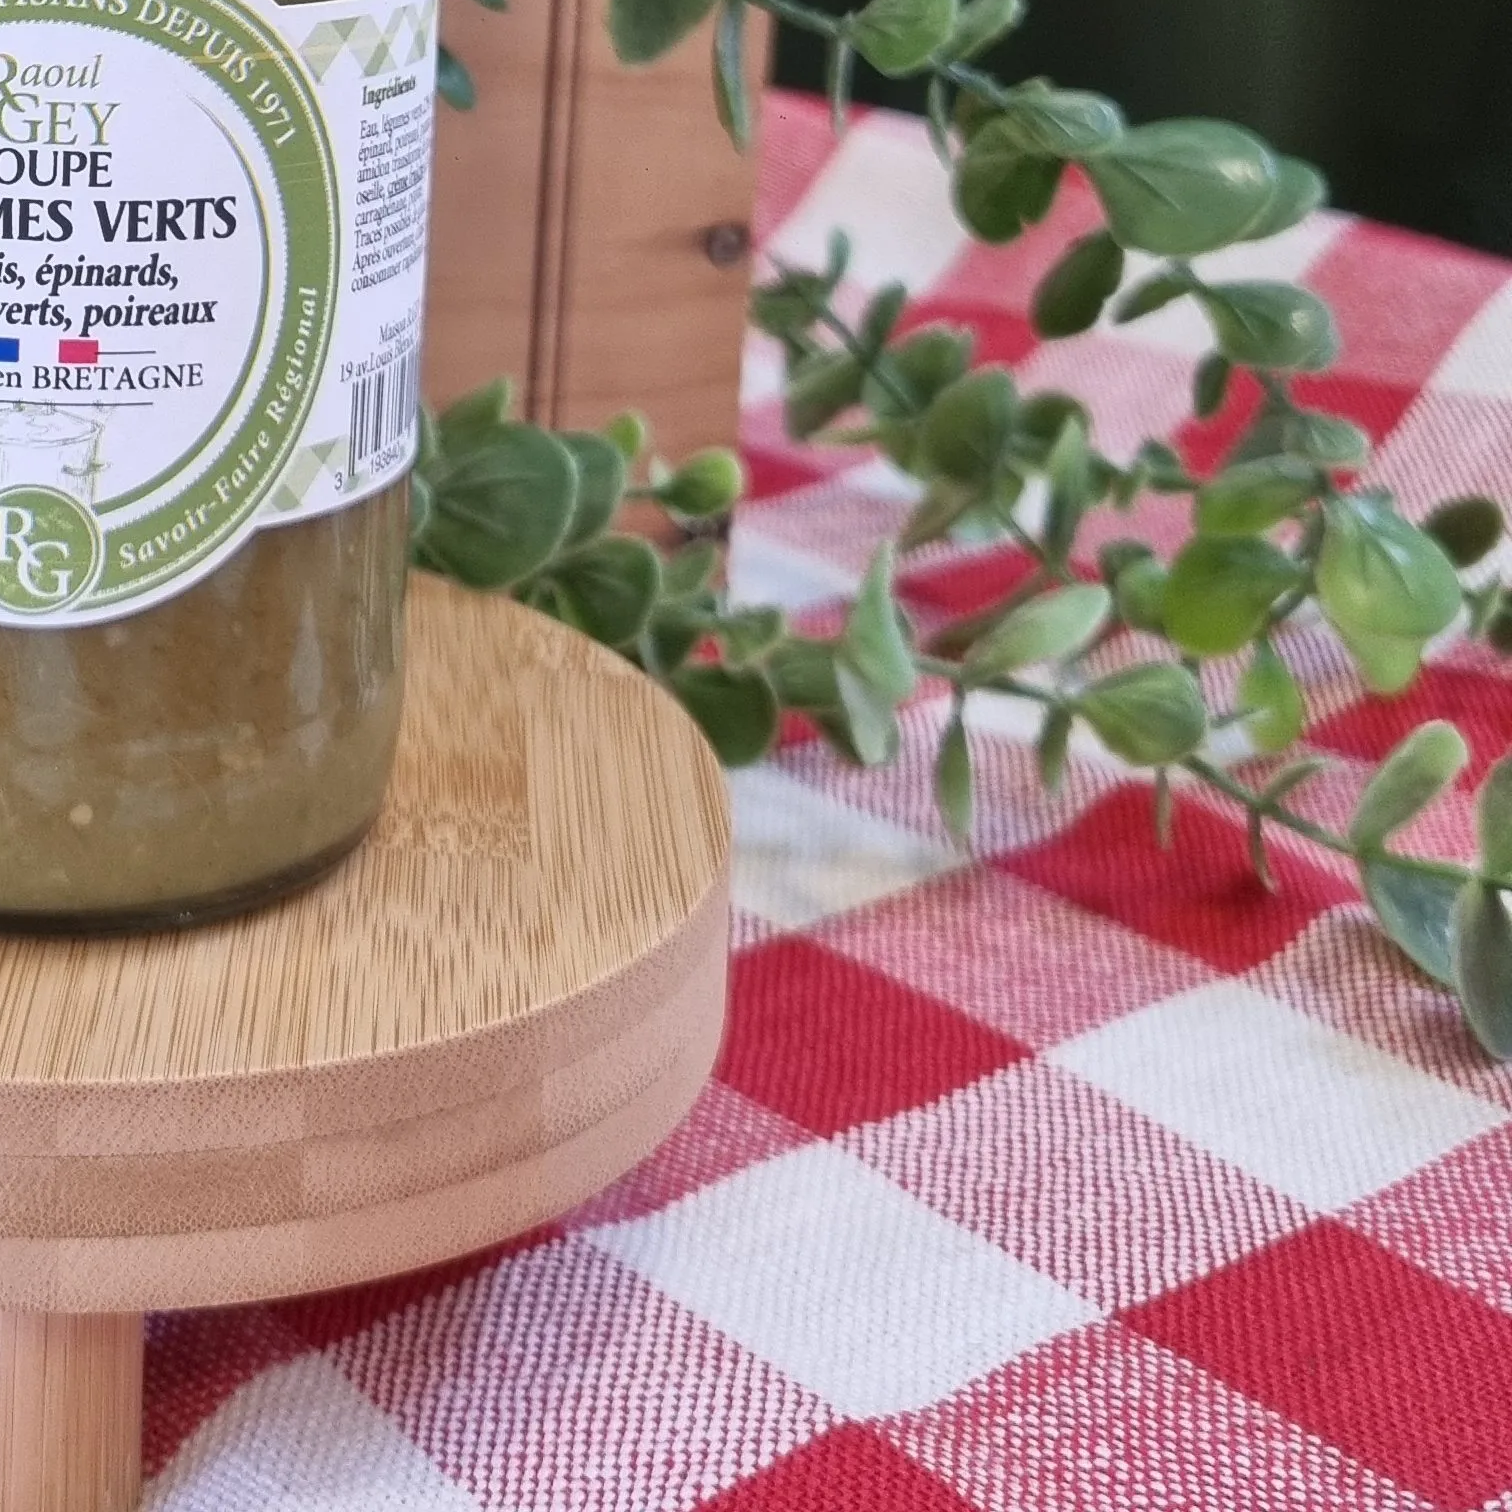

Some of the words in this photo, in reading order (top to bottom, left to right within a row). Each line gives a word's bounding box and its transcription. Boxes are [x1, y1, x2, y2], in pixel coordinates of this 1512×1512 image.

[247, 79, 296, 148] 1971
[94, 195, 237, 242] VERTS
[354, 228, 382, 248] Traces
[35, 252, 179, 296] épinards,
[352, 247, 381, 274] Après
[79, 295, 218, 337] poireaux
[32, 364, 203, 391] BRETAGNE
[340, 361, 353, 382] 19
[119, 433, 271, 569] Savoir-Faire
[266, 287, 317, 425] Régional
[334, 472, 343, 490] 3
